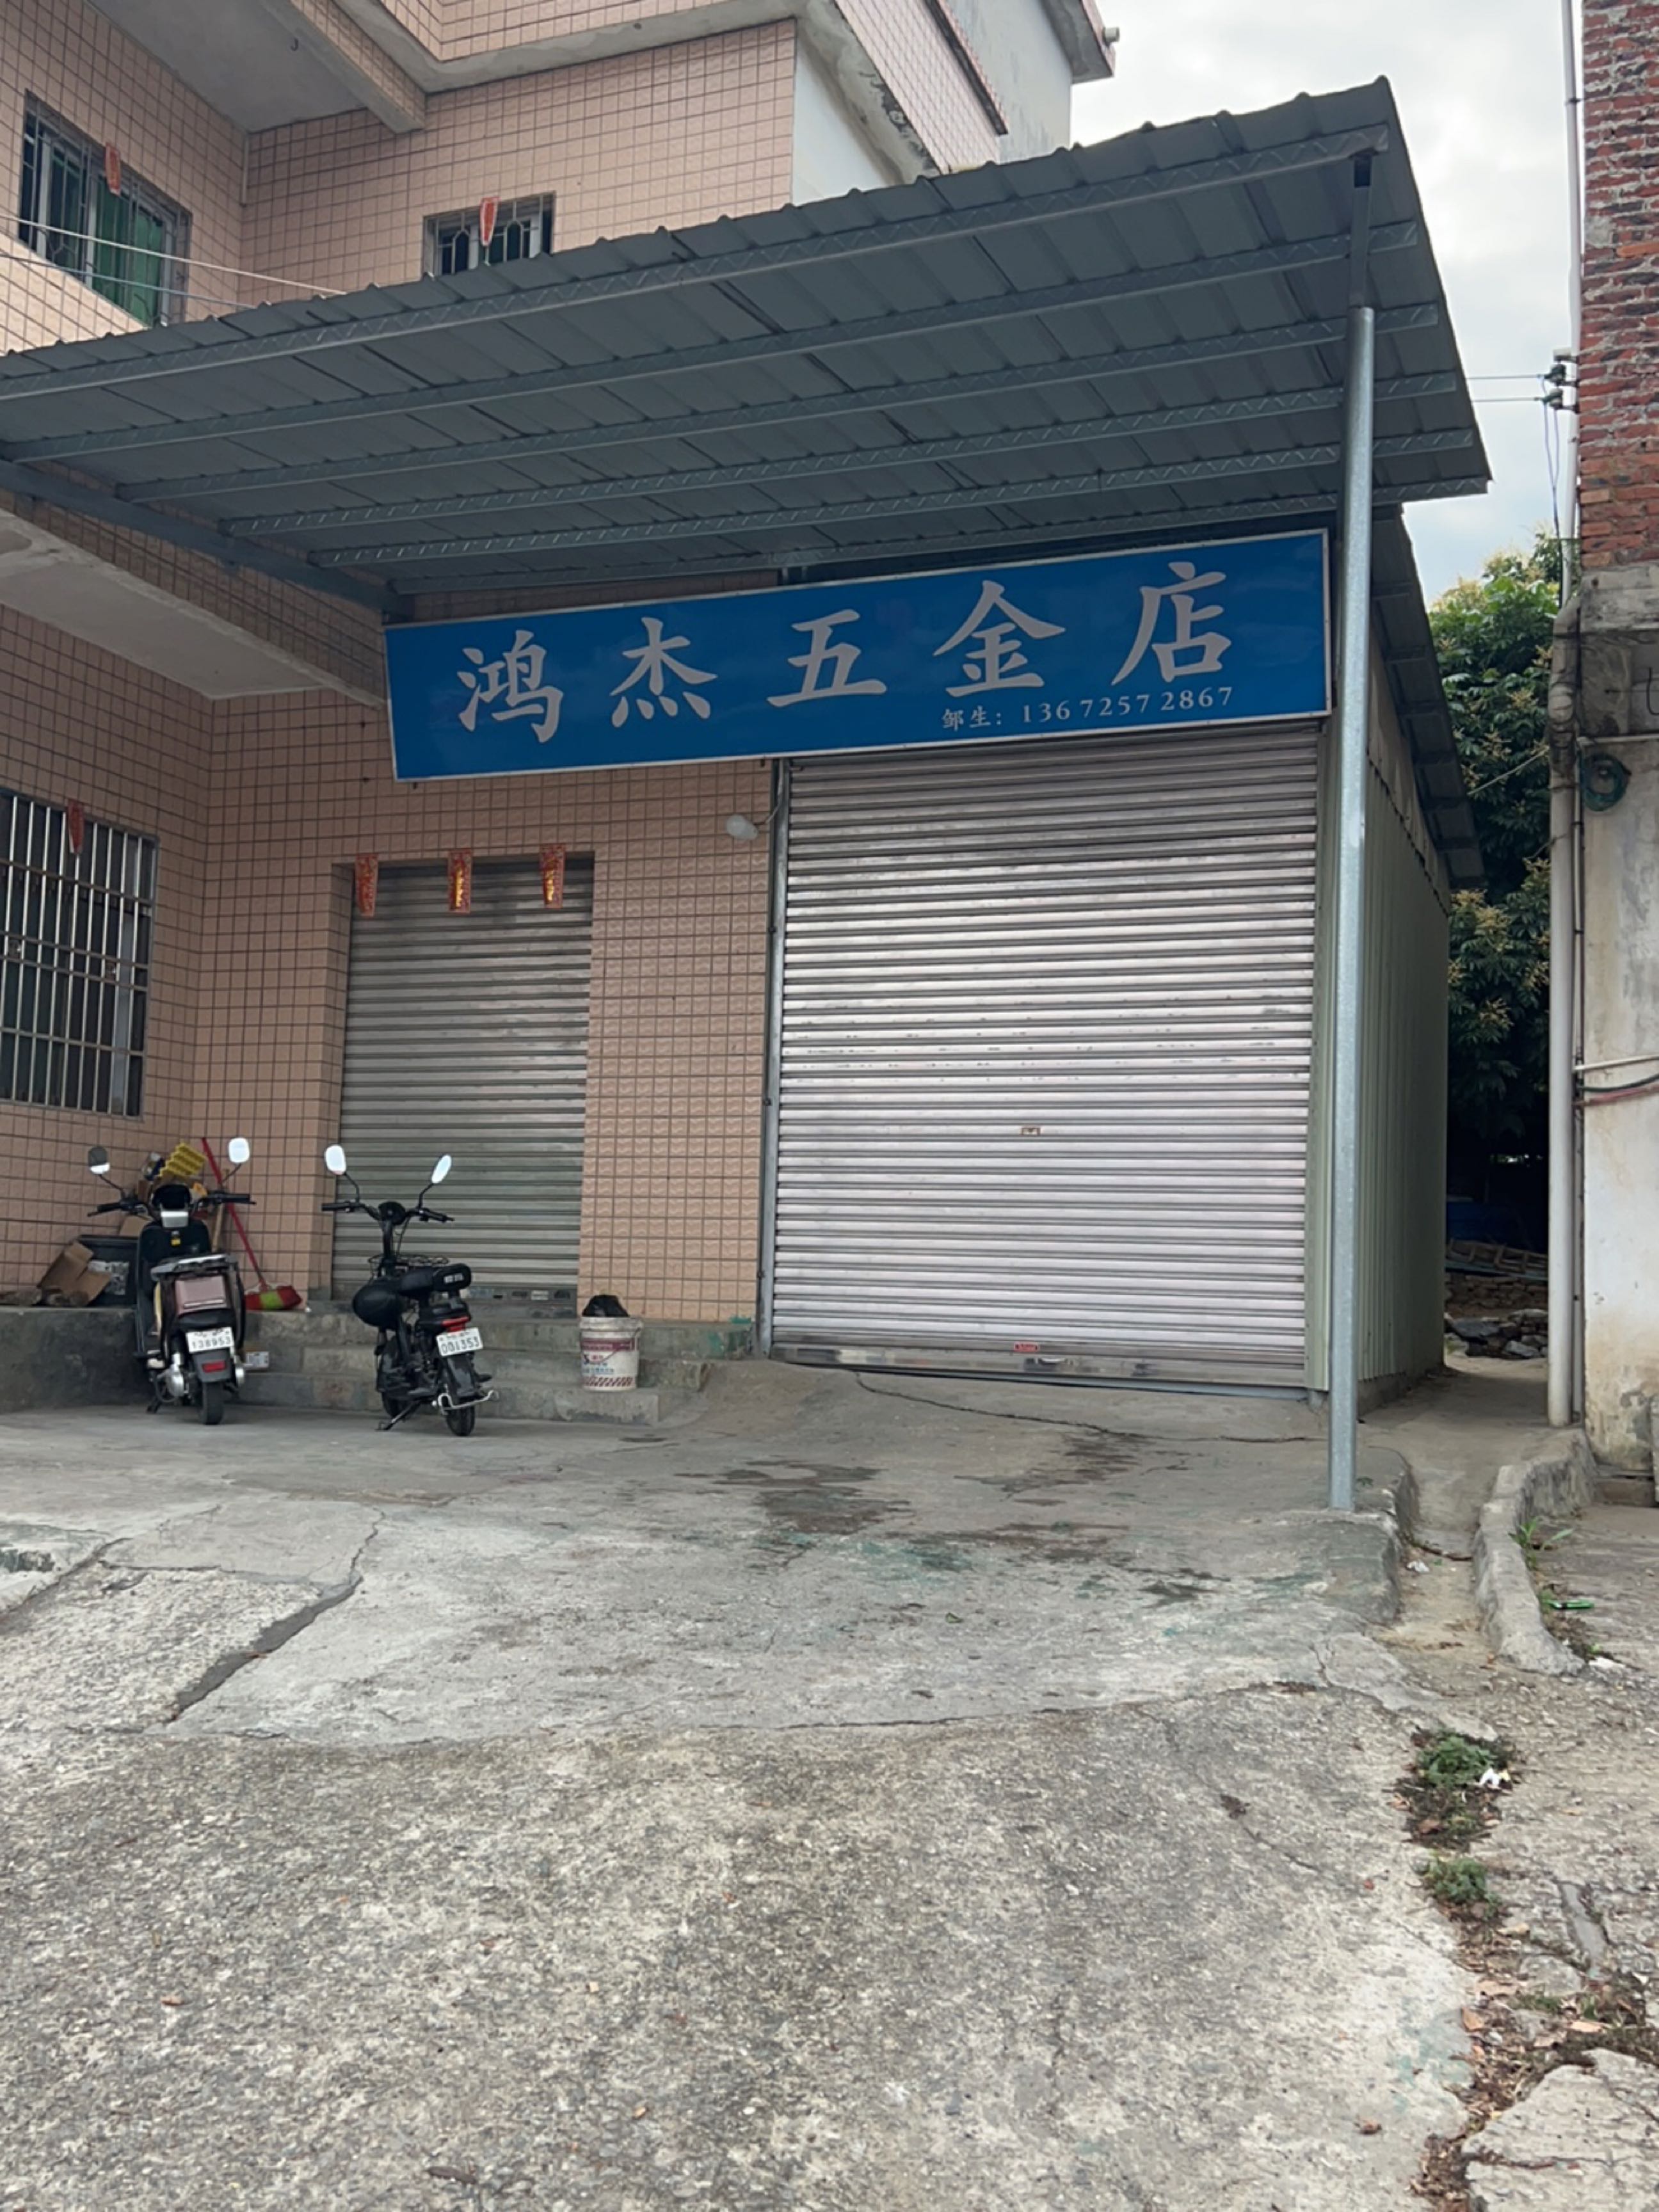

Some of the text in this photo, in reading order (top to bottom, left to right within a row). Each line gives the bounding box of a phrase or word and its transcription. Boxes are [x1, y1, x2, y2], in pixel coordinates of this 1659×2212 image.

[456, 561, 1232, 744] 鸿杰五金店
